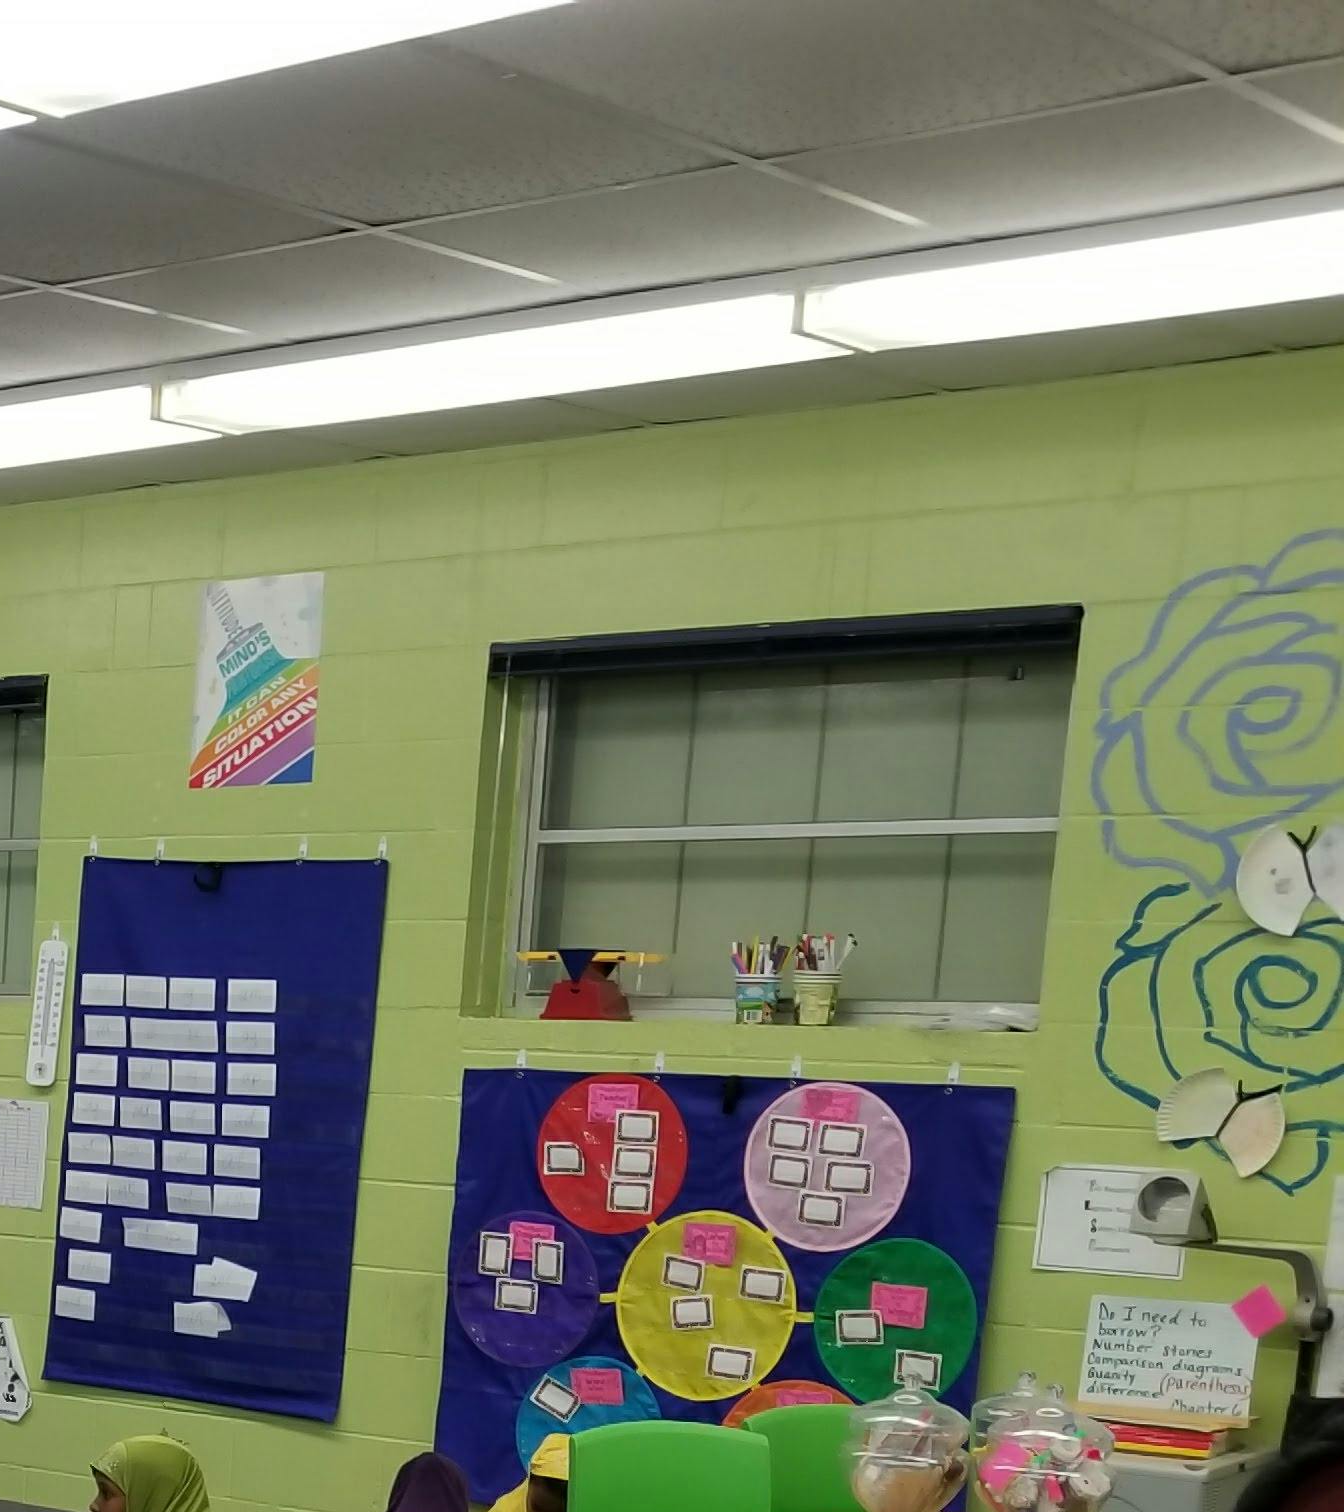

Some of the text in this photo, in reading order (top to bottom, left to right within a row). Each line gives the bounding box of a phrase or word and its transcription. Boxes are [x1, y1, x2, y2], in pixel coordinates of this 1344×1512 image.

[218, 630, 272, 678] MIND'S
[214, 678, 308, 754] COLOR ANY
[228, 676, 286, 724] IT CAN
[202, 695, 318, 788] SITUATION
[1098, 1302, 1208, 1328] Do I need to
[1098, 1322, 1162, 1338] borrow?
[1086, 1352, 1242, 1378] Comparison diagrams
[1092, 1338, 1213, 1358] Number stories
